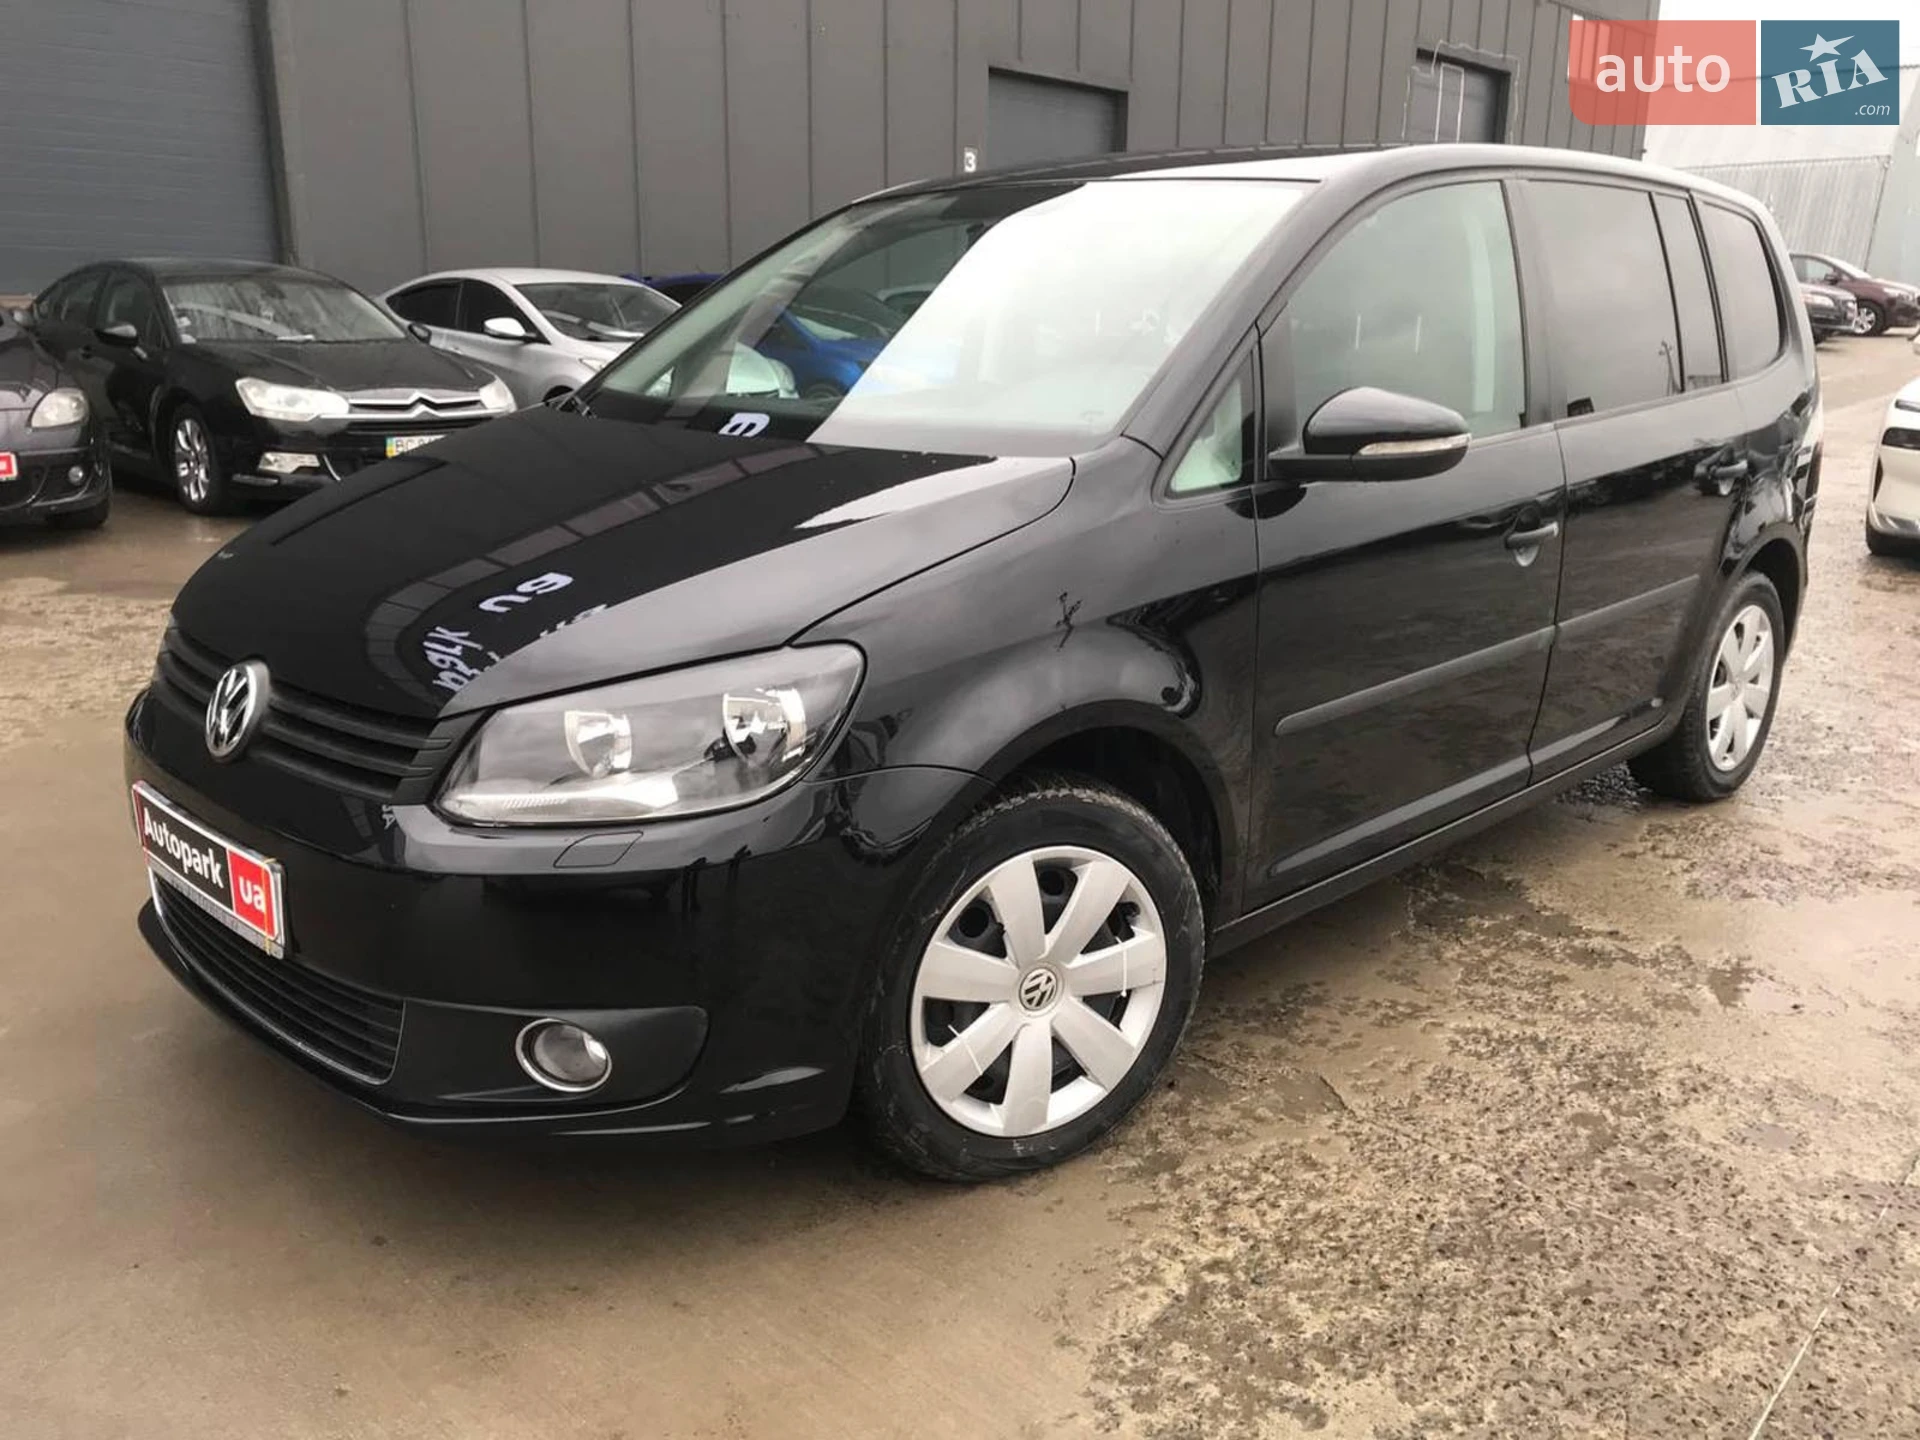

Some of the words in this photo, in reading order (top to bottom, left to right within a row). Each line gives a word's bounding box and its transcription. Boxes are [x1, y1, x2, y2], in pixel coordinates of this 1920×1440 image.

[964, 151, 977, 172] 3
[142, 806, 225, 889] Autopark
[238, 875, 266, 915] ua
